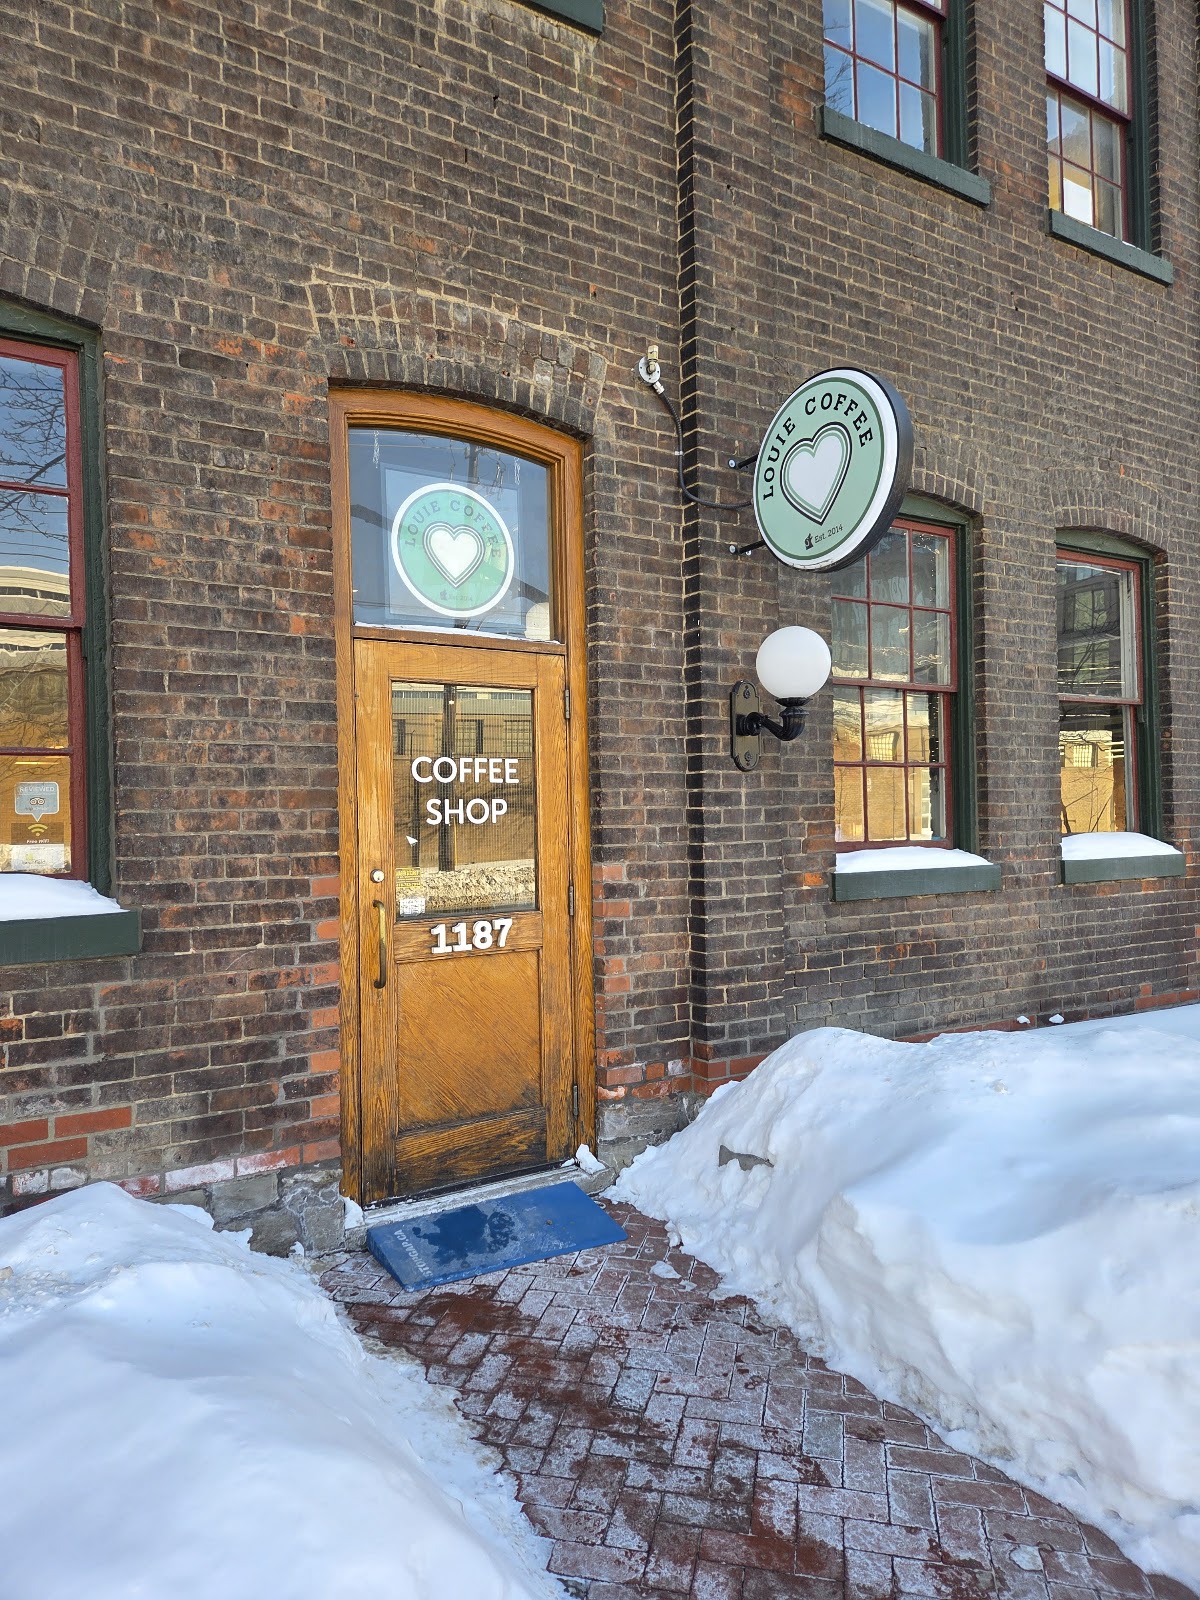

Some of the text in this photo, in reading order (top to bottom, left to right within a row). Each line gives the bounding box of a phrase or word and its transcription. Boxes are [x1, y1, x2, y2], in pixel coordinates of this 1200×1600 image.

[763, 392, 874, 500] LOUIE COFFEE
[405, 499, 502, 558] LOUIE COFFEE
[814, 523, 843, 543] Est. 2014
[411, 756, 520, 784] COFFEE
[426, 798, 508, 825] SHOP
[430, 918, 513, 954] 1187
[393, 1229, 433, 1278] STOPGAP.CA
